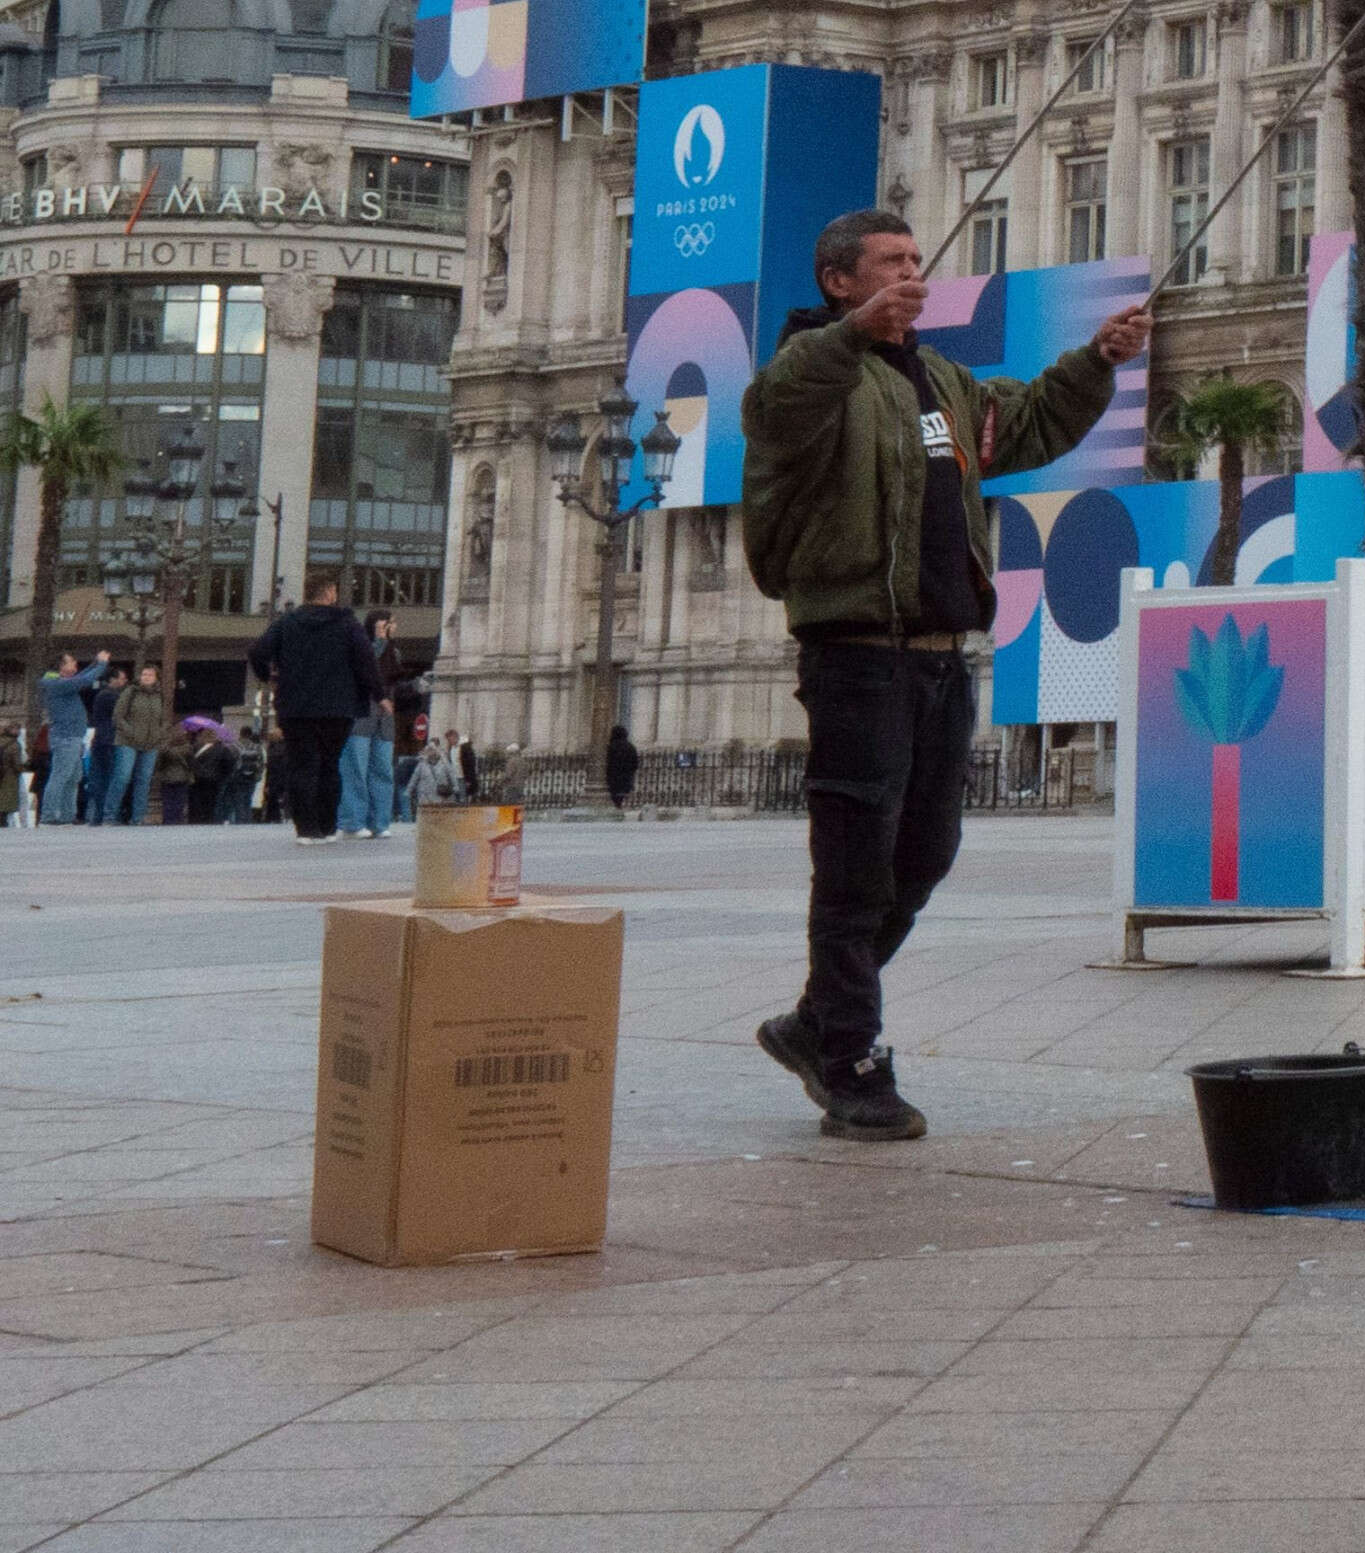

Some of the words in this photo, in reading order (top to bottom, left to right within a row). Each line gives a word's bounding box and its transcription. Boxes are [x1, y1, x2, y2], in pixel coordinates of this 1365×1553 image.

[35, 185, 120, 218] BHV
[162, 185, 384, 221] MARAIS
[656, 199, 696, 217] PARIS
[699, 193, 736, 213] 2024
[48, 249, 76, 270] DE
[279, 247, 318, 270] DE
[338, 245, 453, 280] VILLE
